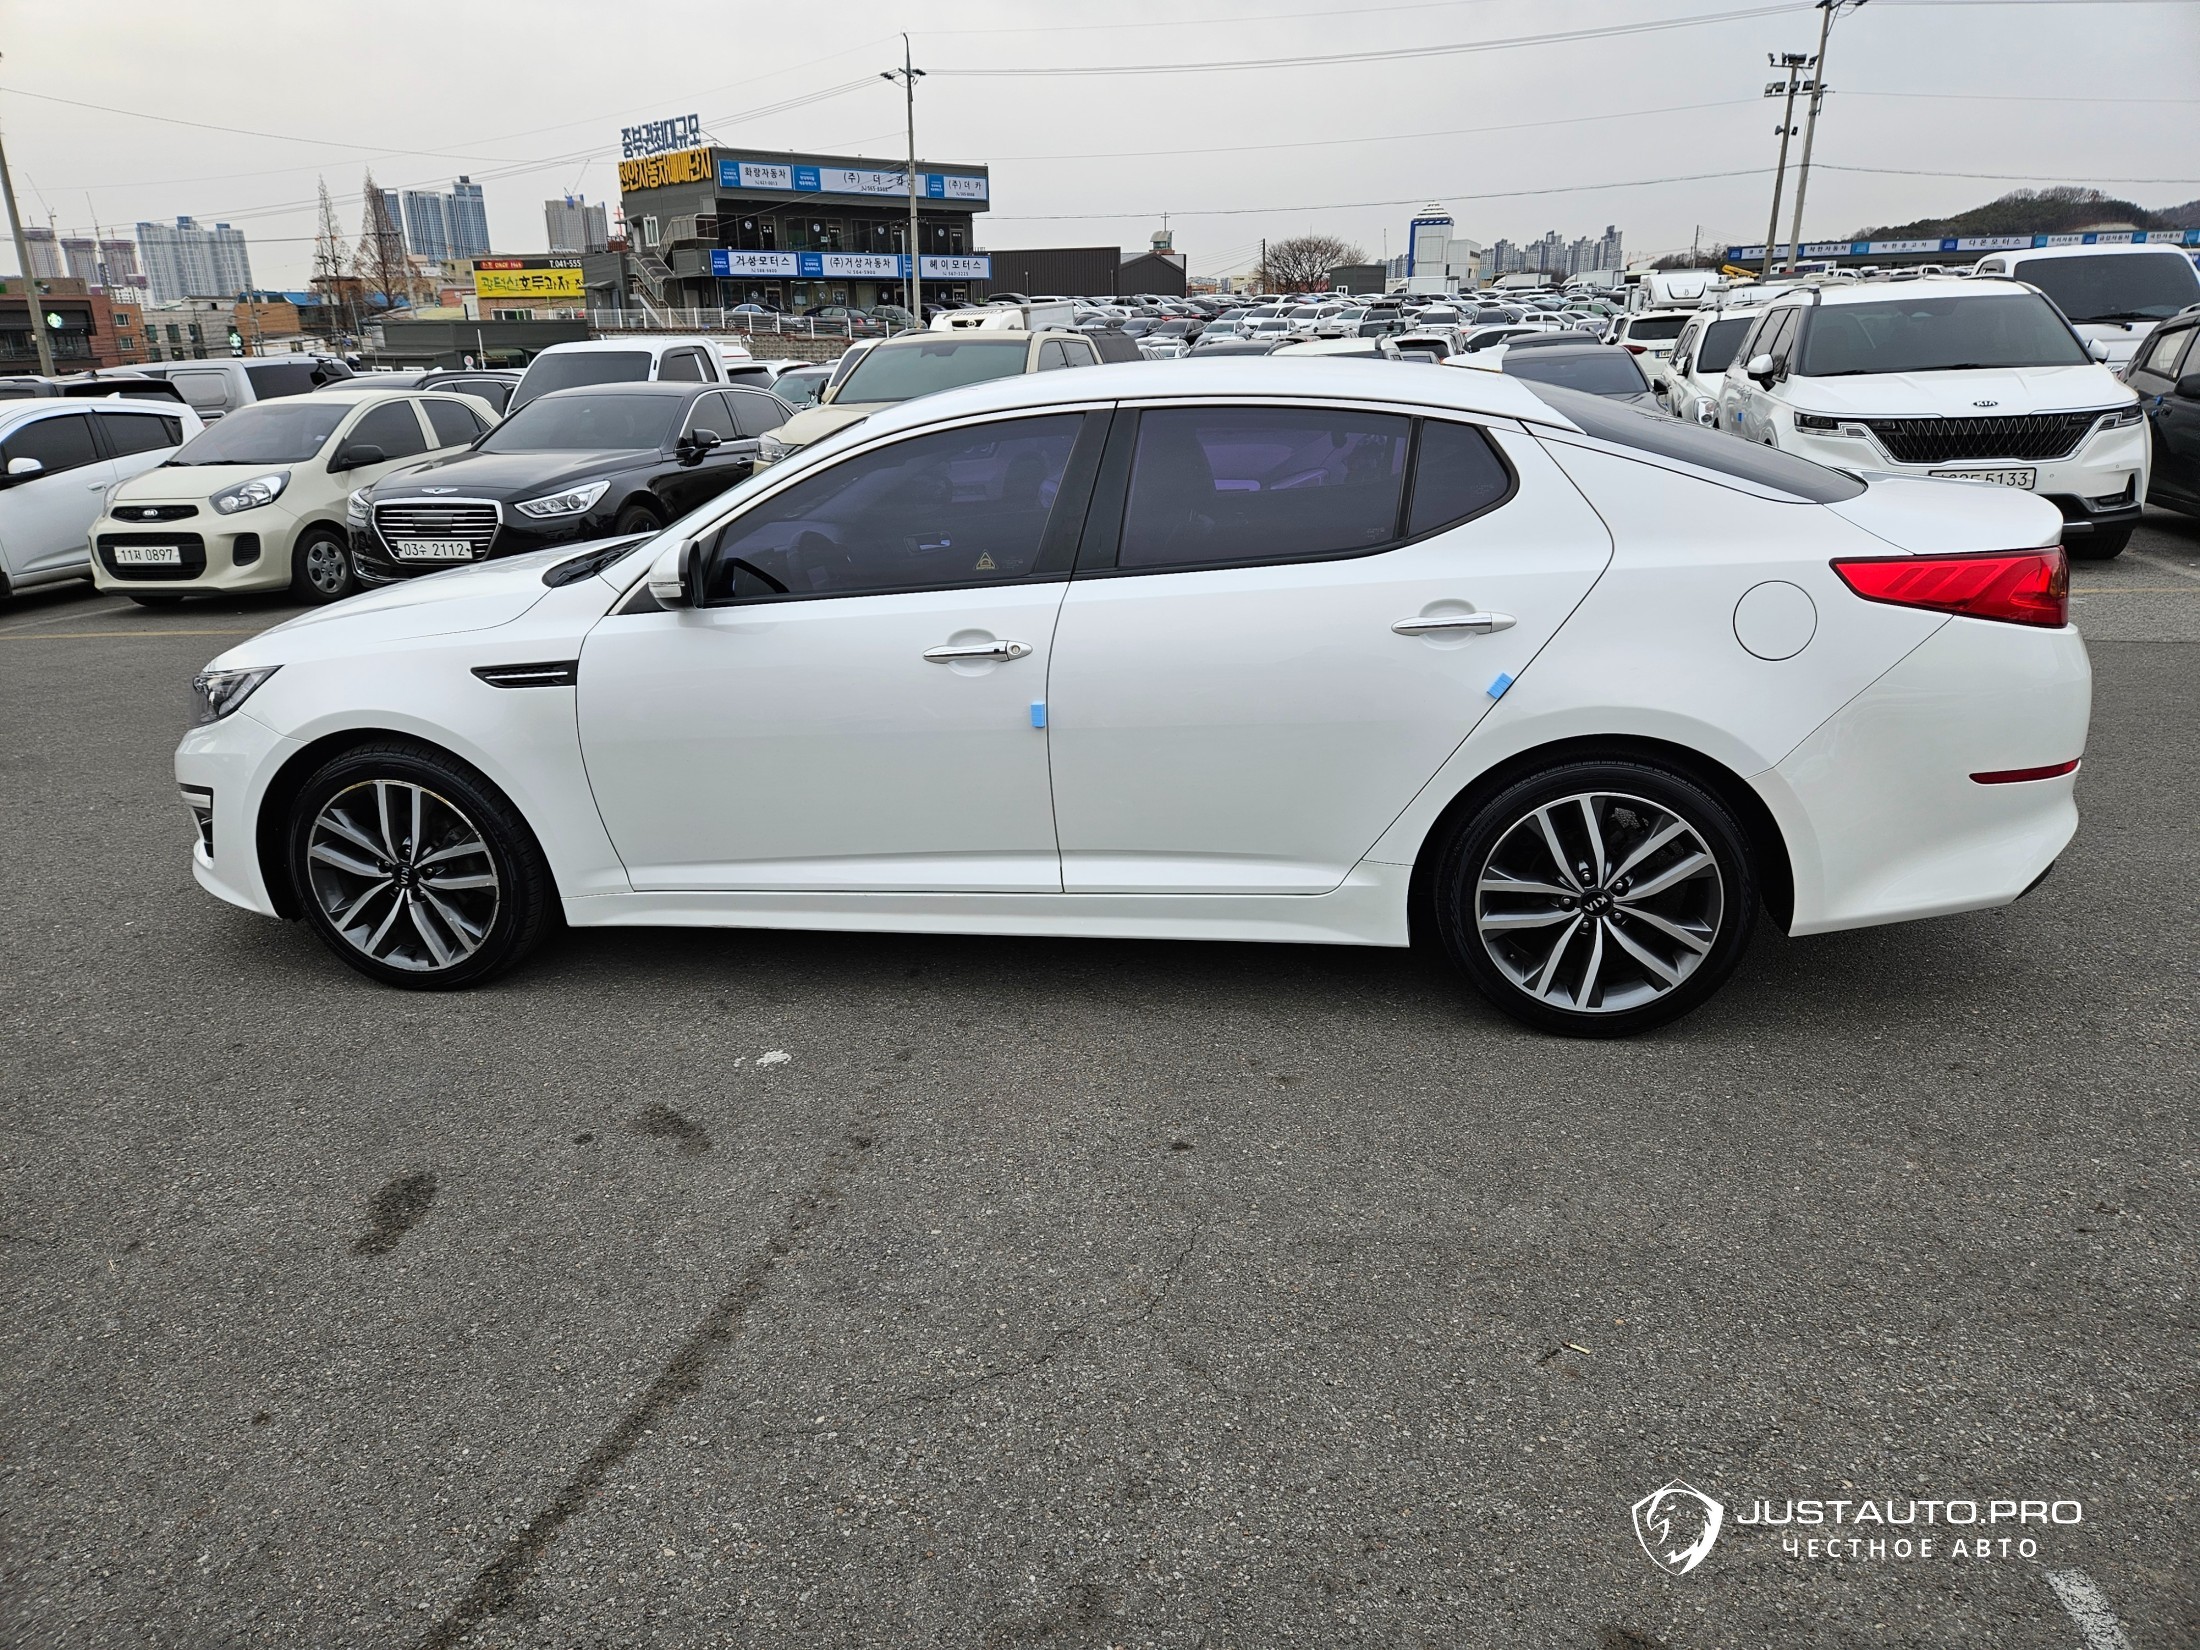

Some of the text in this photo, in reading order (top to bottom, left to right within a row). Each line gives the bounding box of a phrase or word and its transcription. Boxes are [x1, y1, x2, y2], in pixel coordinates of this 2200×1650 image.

[621, 113, 701, 158] 중부권최대규모
[618, 147, 712, 192] 천안자동차매매단지
[744, 166, 787, 180] 화랑자동차
[843, 171, 860, 184] (주)
[948, 179, 962, 190] (주)
[736, 255, 790, 267] 거성모터스
[929, 259, 981, 270] 헤이모터스
[145, 548, 172, 561] 0897
[404, 543, 465, 556] 03수 2112
[400, 867, 410, 885] KIA
[1584, 895, 1608, 911] KIA
